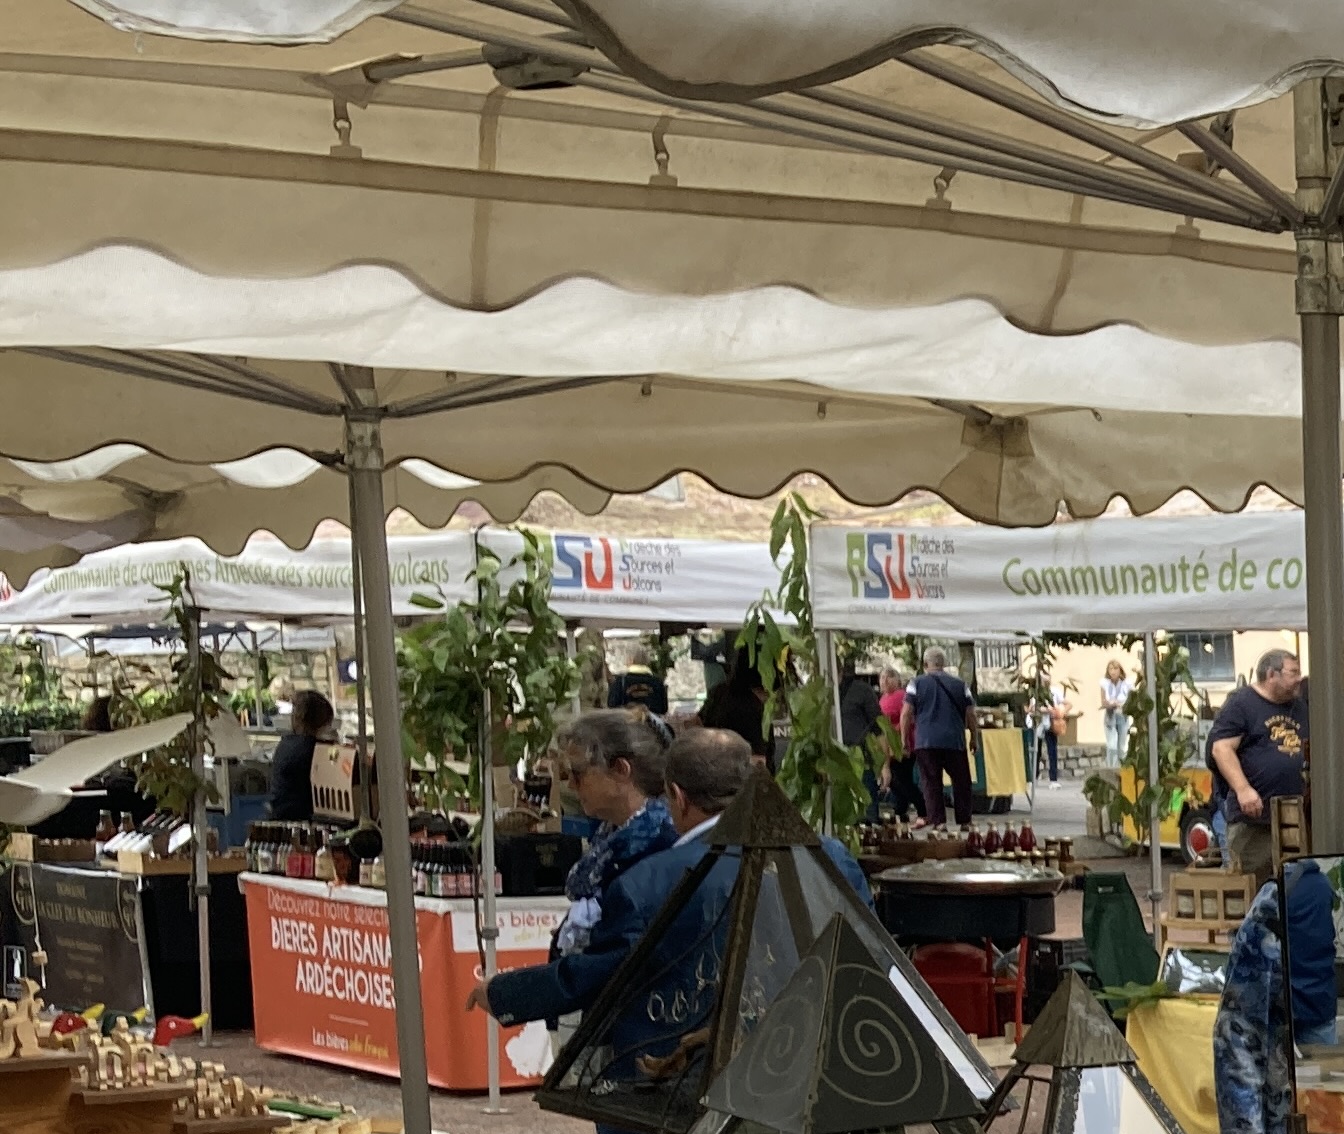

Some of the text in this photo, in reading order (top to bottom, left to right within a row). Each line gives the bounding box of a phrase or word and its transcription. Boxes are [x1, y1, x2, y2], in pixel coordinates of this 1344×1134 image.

[306, 564, 353, 588] sourc
[390, 552, 450, 586] volcans
[1002, 549, 1208, 596] Communauté
[1217, 547, 1257, 592] de
[267, 887, 321, 918] Découvrez
[271, 916, 318, 957] BIERES
[322, 923, 422, 974] ARTISANA
